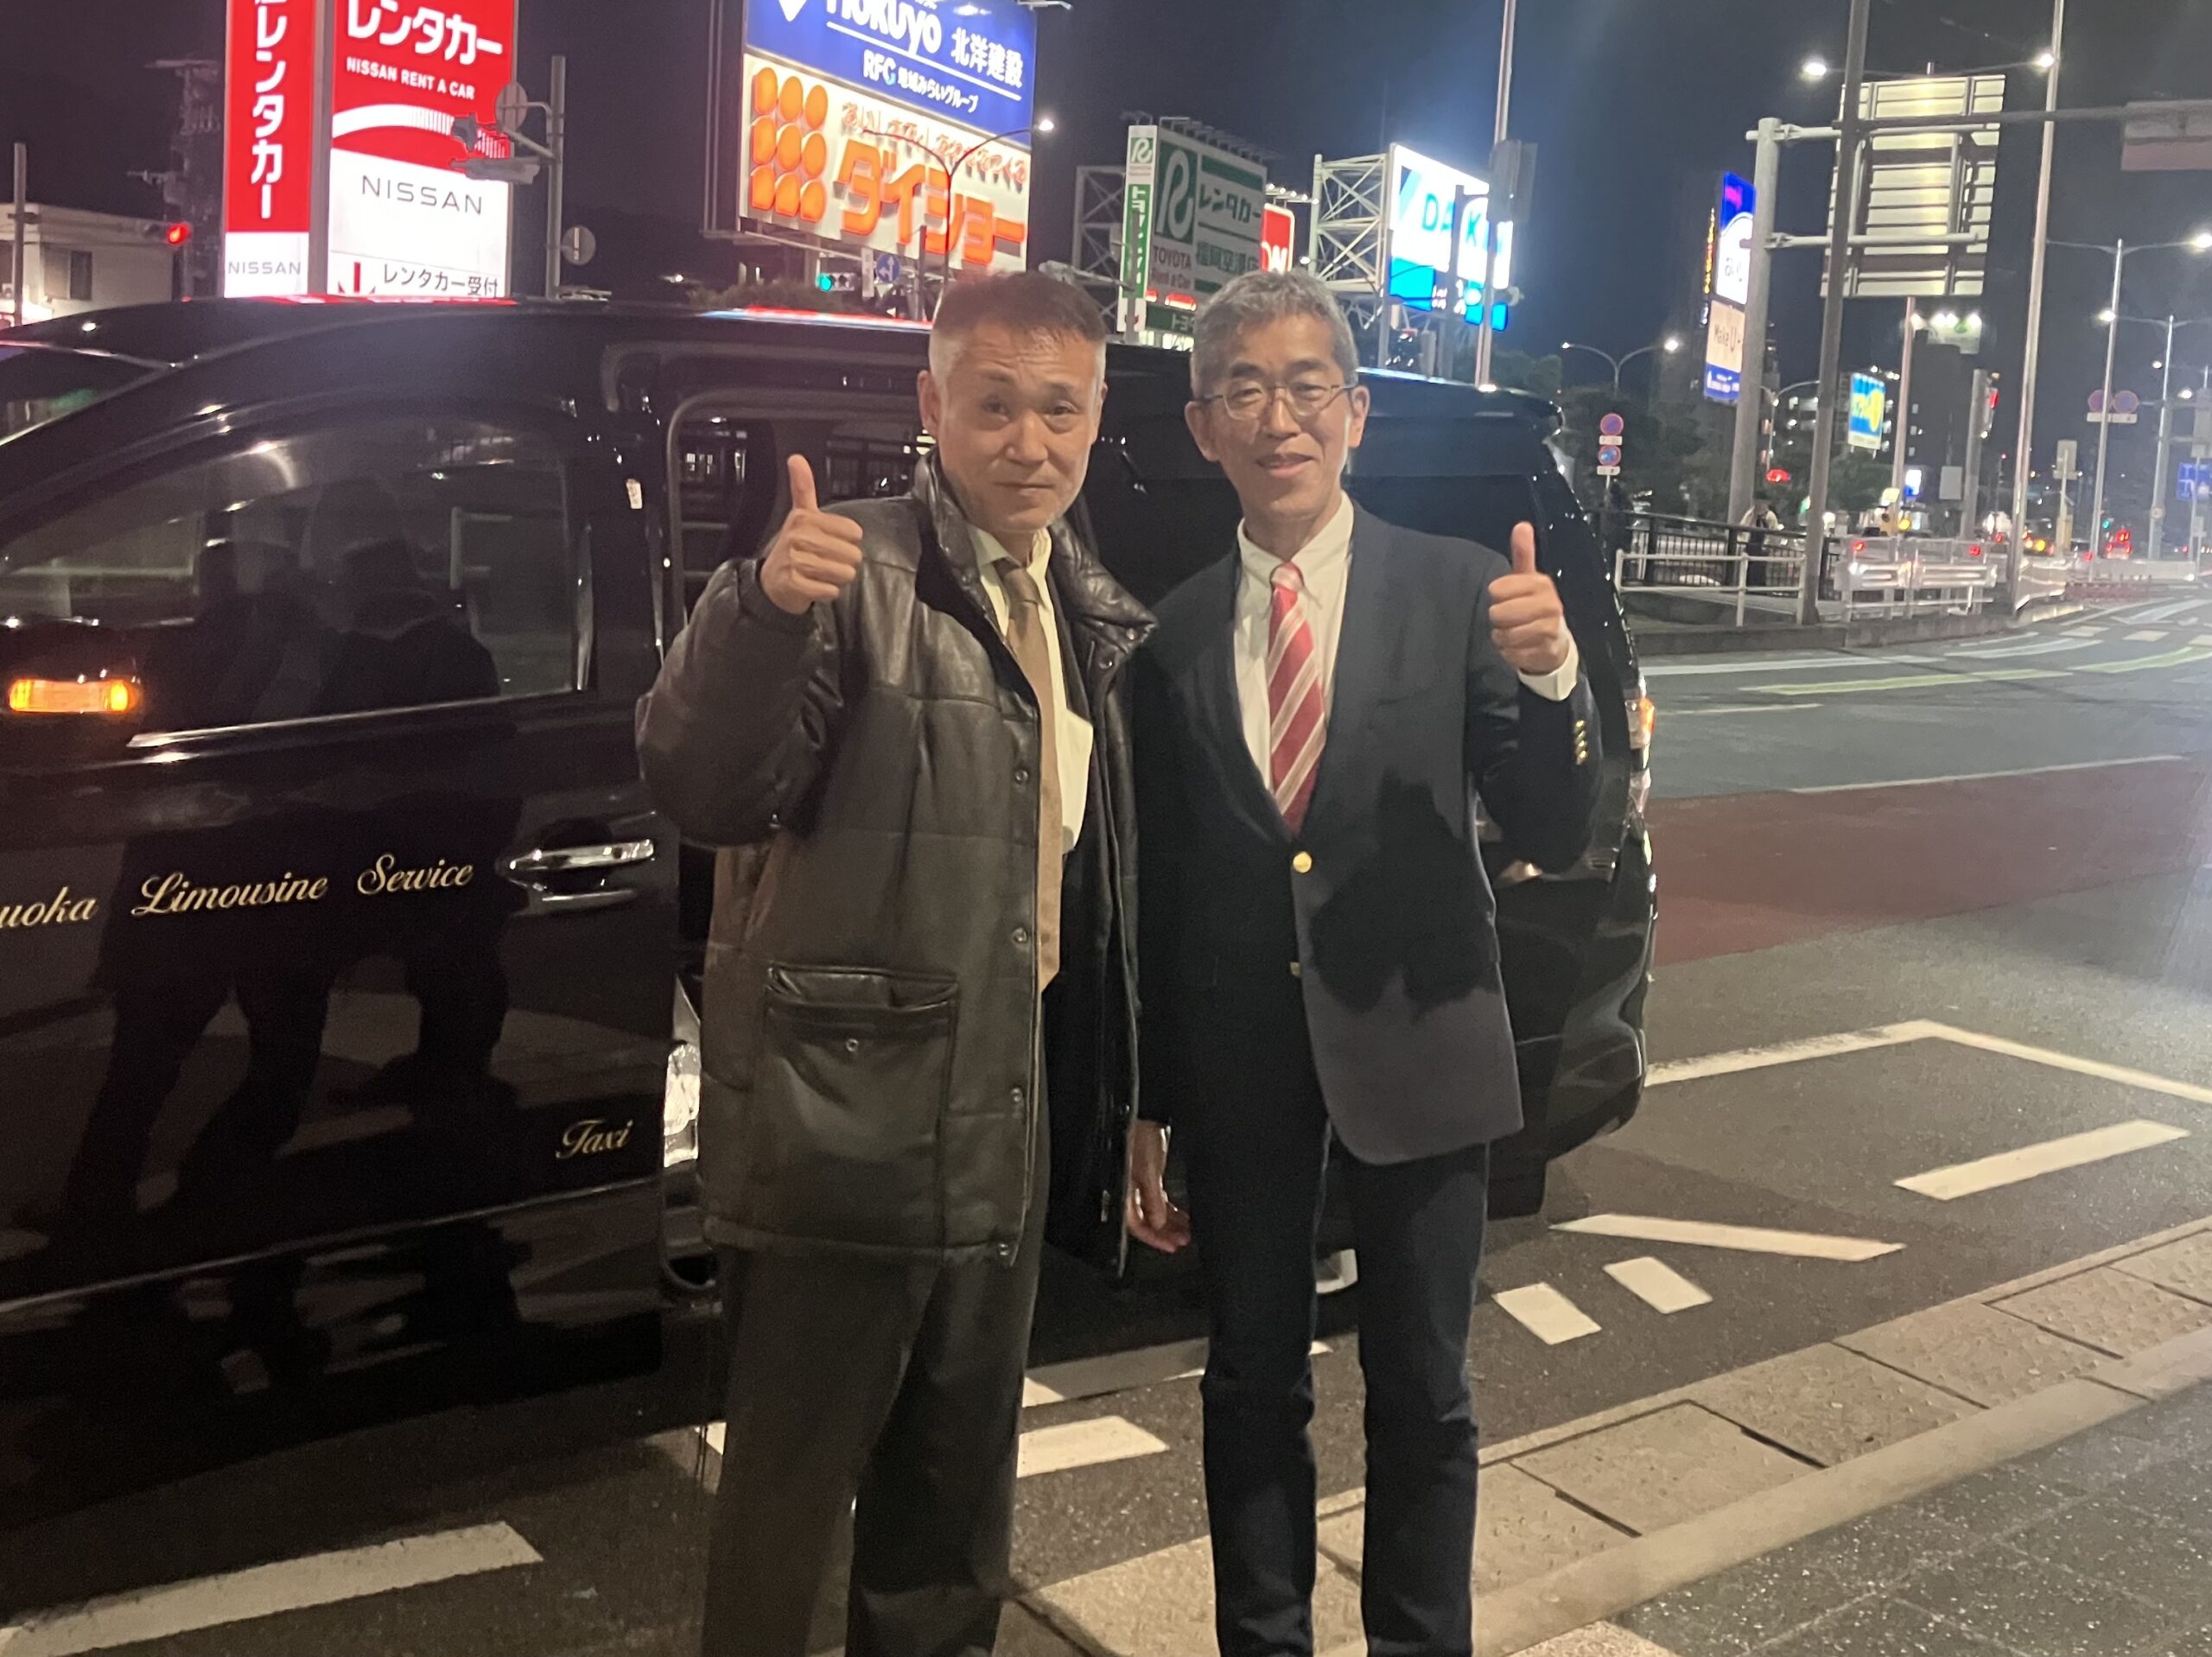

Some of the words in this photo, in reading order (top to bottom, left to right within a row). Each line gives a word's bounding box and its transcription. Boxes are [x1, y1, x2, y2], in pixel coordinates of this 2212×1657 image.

[347, 0, 503, 66] レンタカー
[346, 56, 397, 82] NISSAN
[401, 68, 435, 91] RENT
[436, 78, 447, 93] A
[448, 80, 475, 100] CAR
[862, 49, 896, 86] RFC
[950, 27, 1023, 88] 北洋建設
[251, 0, 288, 219] レンタカー
[362, 175, 483, 215] NISSAN
[835, 138, 1026, 266] ダイショー
[228, 262, 301, 275] NISSAN
[1153, 245, 1192, 270] TOYOTA
[383, 263, 499, 298] レンタカー受付
[130, 872, 328, 916] Limousine
[357, 854, 474, 895] Service
[556, 1120, 633, 1158] Taxi
